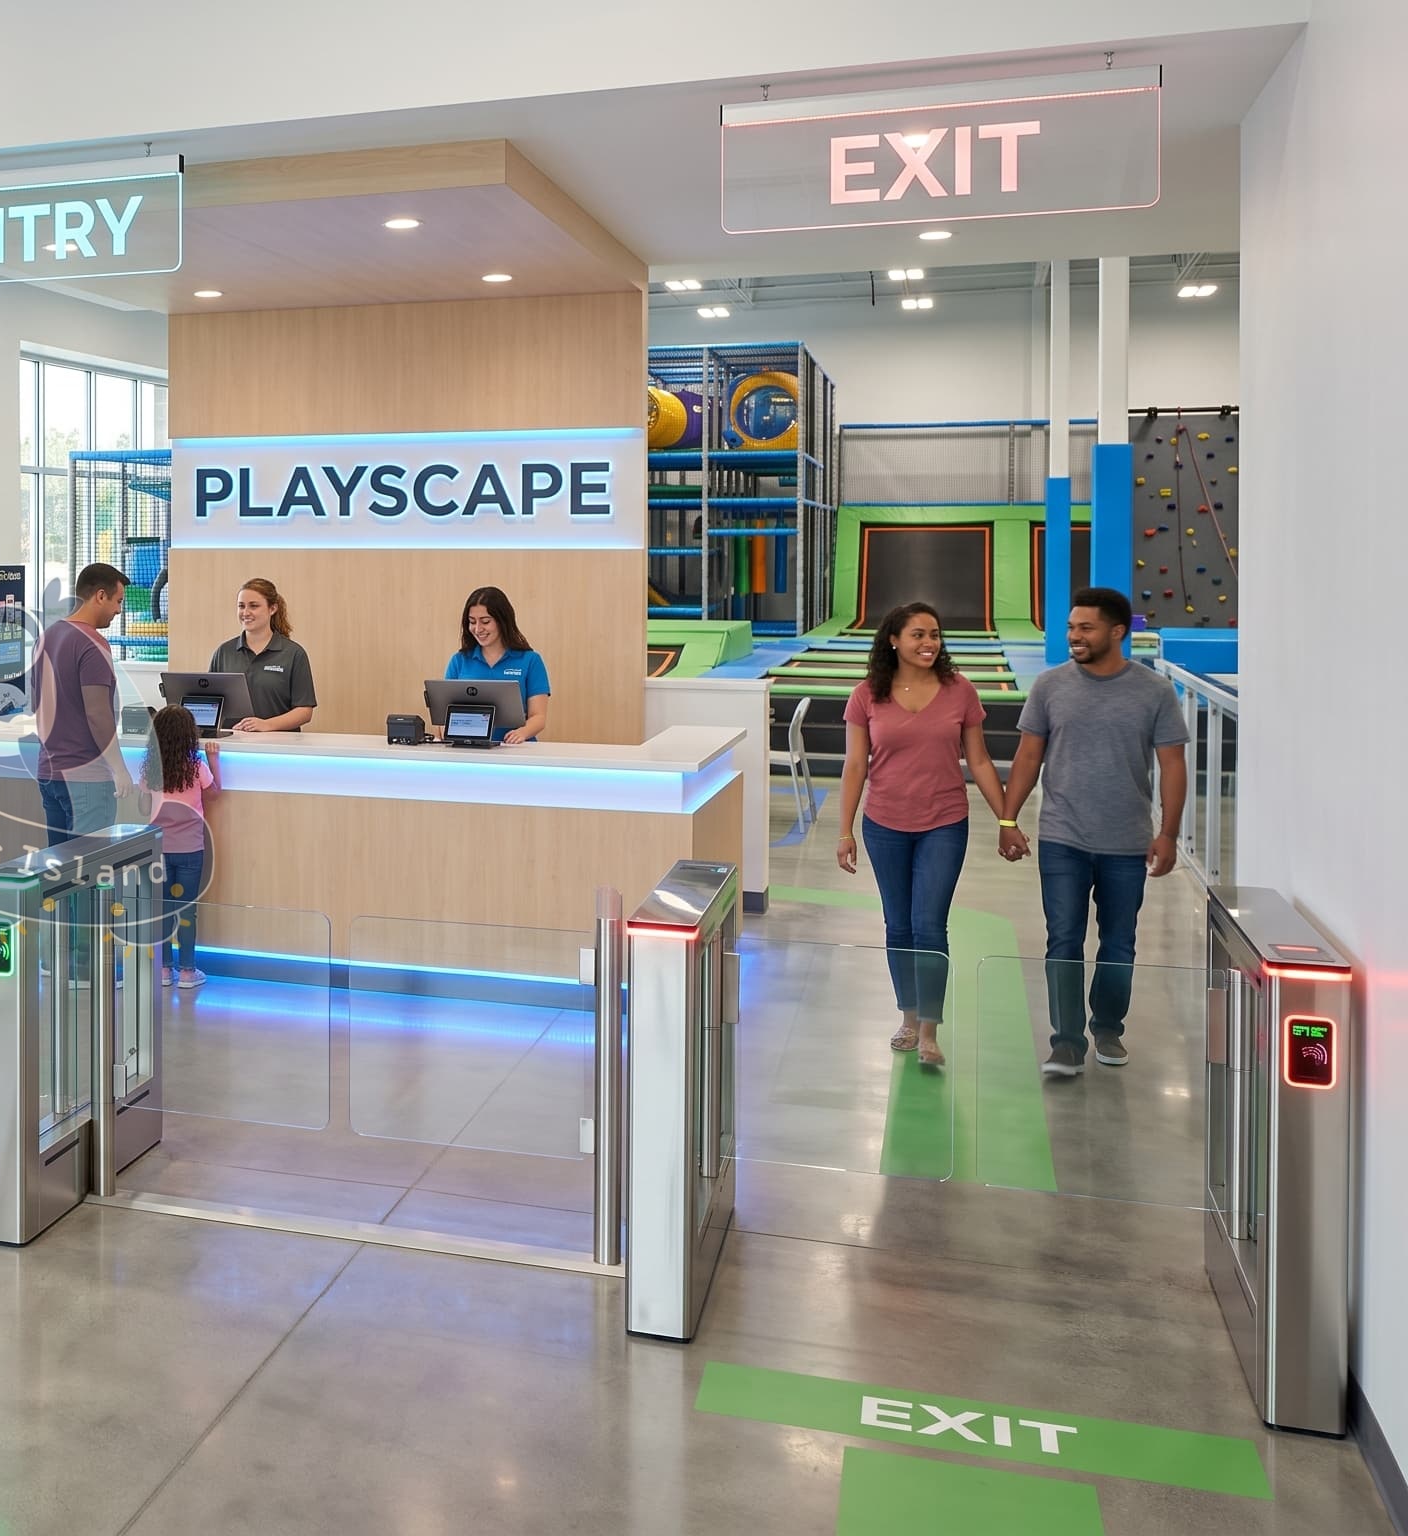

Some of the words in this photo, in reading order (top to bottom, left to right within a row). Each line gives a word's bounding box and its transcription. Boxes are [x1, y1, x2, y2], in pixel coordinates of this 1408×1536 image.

[829, 120, 1042, 205] EXIT
[194, 461, 611, 518] PLAYSCAPE
[859, 1395, 1079, 1455] EXIT
